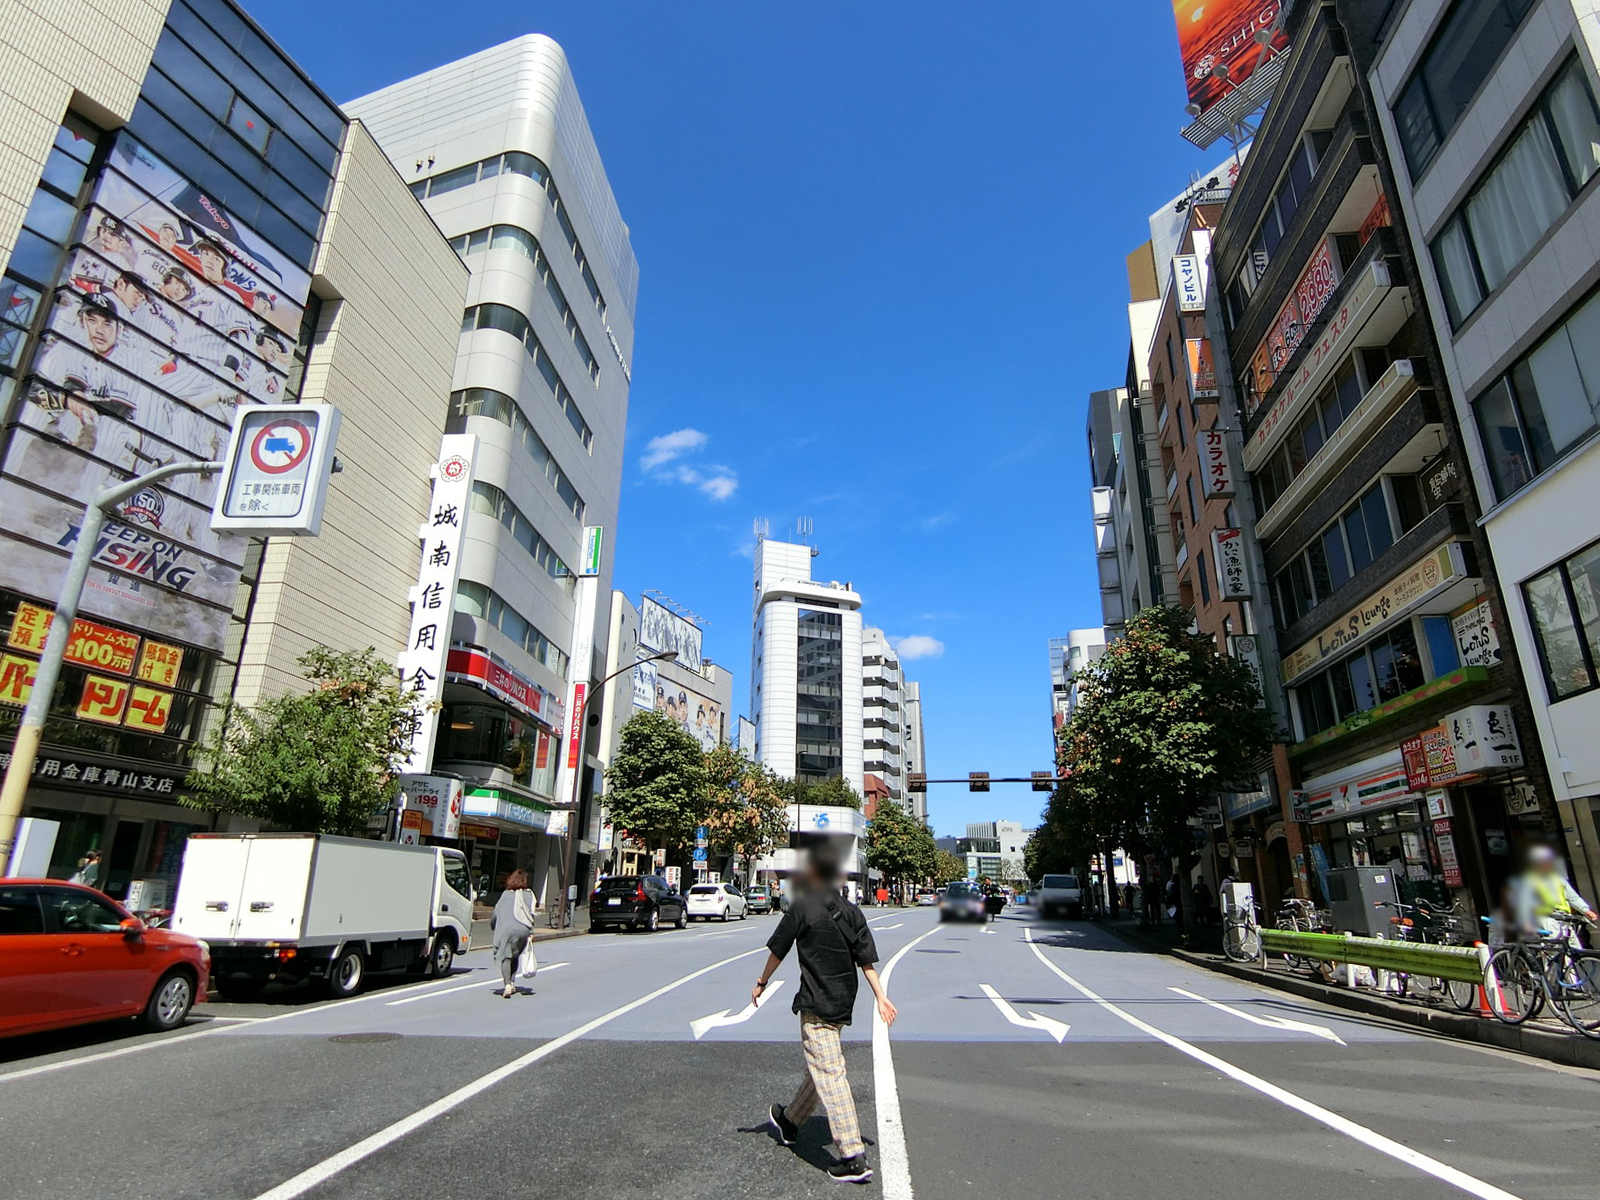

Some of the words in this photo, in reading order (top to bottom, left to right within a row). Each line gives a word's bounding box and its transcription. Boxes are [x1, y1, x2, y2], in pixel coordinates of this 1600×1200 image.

[199, 194, 229, 229] Tokyo
[1180, 259, 1197, 302] コヤノビル
[1258, 367, 1311, 445] カラオケルーム
[1313, 307, 1350, 366] フェスタ
[1207, 432, 1229, 492] カラオケ
[239, 498, 269, 512] を除く
[242, 483, 302, 496] 工事関係車両
[152, 541, 184, 561] ON
[1223, 541, 1245, 594] かに漁師の家
[73, 623, 138, 649] ドリーム大賞
[74, 637, 133, 670] 100万円
[142, 662, 174, 683] 付き
[494, 669, 527, 702] 三井のリハウス
[82, 680, 166, 728] ドリーム
[572, 693, 583, 740] 三井のリハウス
[1501, 755, 1520, 764] B1F
[417, 795, 439, 805] 199
